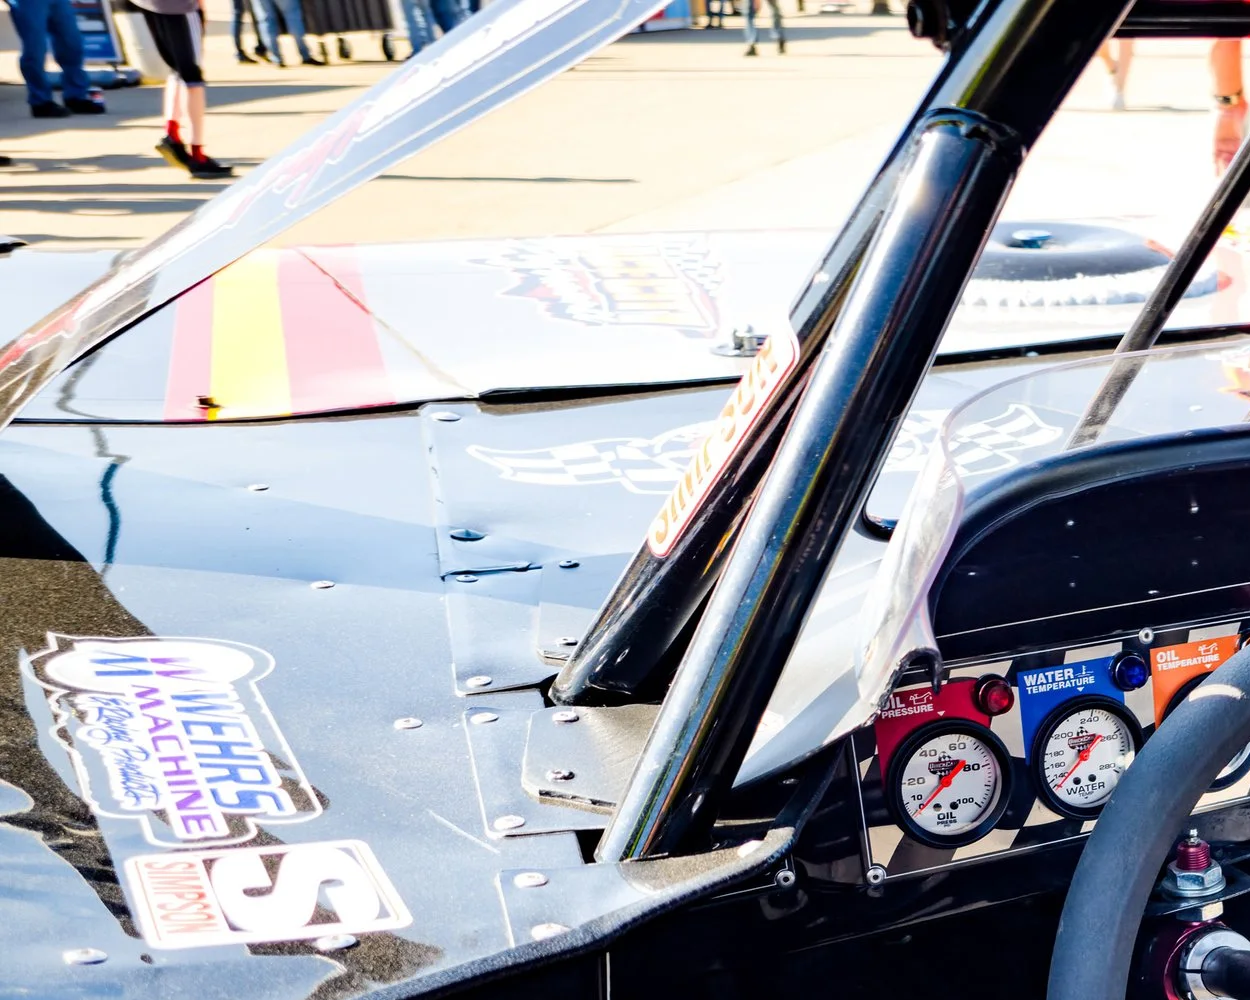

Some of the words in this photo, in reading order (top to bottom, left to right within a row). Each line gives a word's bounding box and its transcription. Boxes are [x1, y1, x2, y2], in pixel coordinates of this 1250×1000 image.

[1156, 649, 1180, 663] OIL
[1157, 653, 1220, 671] TEMPERATURE
[1023, 667, 1074, 687] WATER
[1026, 675, 1095, 695] TEMPERATURE
[881, 703, 934, 719] PRESSURE
[1080, 716, 1100, 724] 240
[1054, 731, 1074, 740] 200
[170, 688, 285, 813] WEHRS
[948, 742, 967, 752] 60
[131, 684, 218, 834] MACHINE
[919, 749, 938, 758] 40
[1049, 750, 1065, 758] 180
[962, 763, 981, 772] 80
[1099, 763, 1116, 771] 280
[907, 776, 926, 786] 20
[1066, 781, 1106, 796] WATER
[937, 811, 957, 821] OIL
[144, 860, 222, 934] SIMPSON
